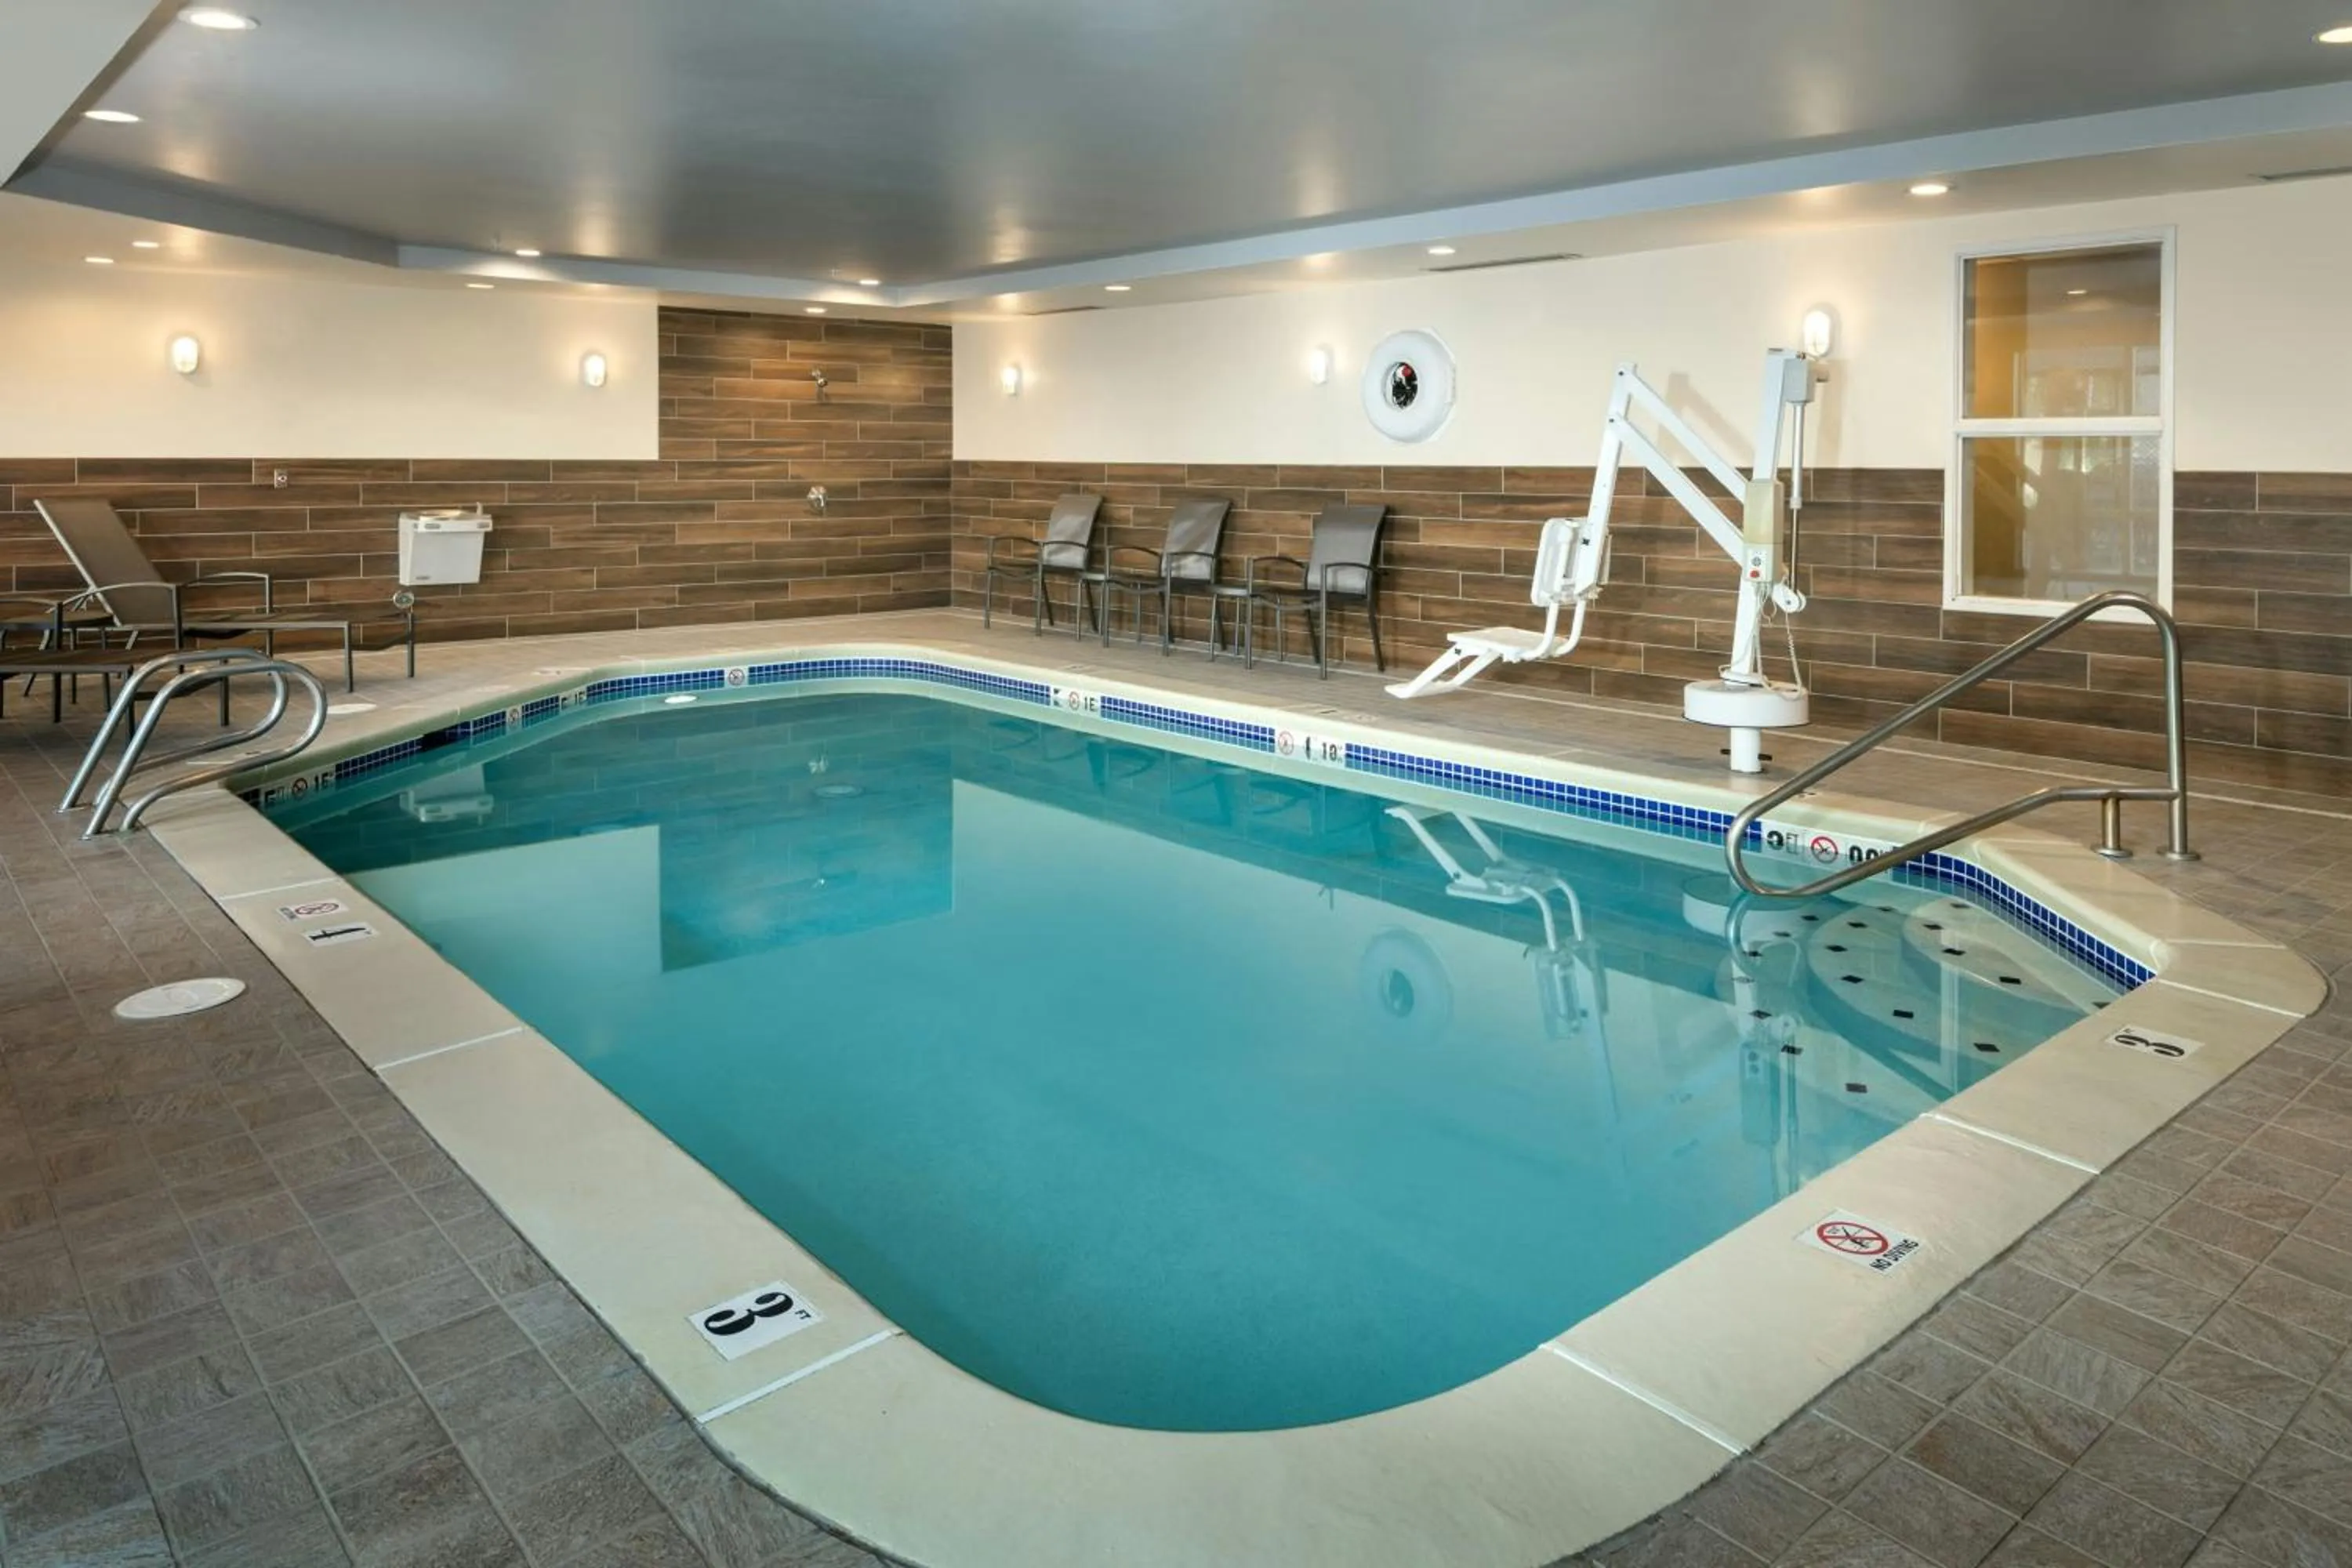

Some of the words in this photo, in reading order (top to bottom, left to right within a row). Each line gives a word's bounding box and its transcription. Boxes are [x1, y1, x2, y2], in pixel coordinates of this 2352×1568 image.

[2114, 1035, 2185, 1057] 3
[1869, 1258, 1892, 1271] NO
[1883, 1238, 1919, 1261] DIVING
[704, 1292, 793, 1336] 3
